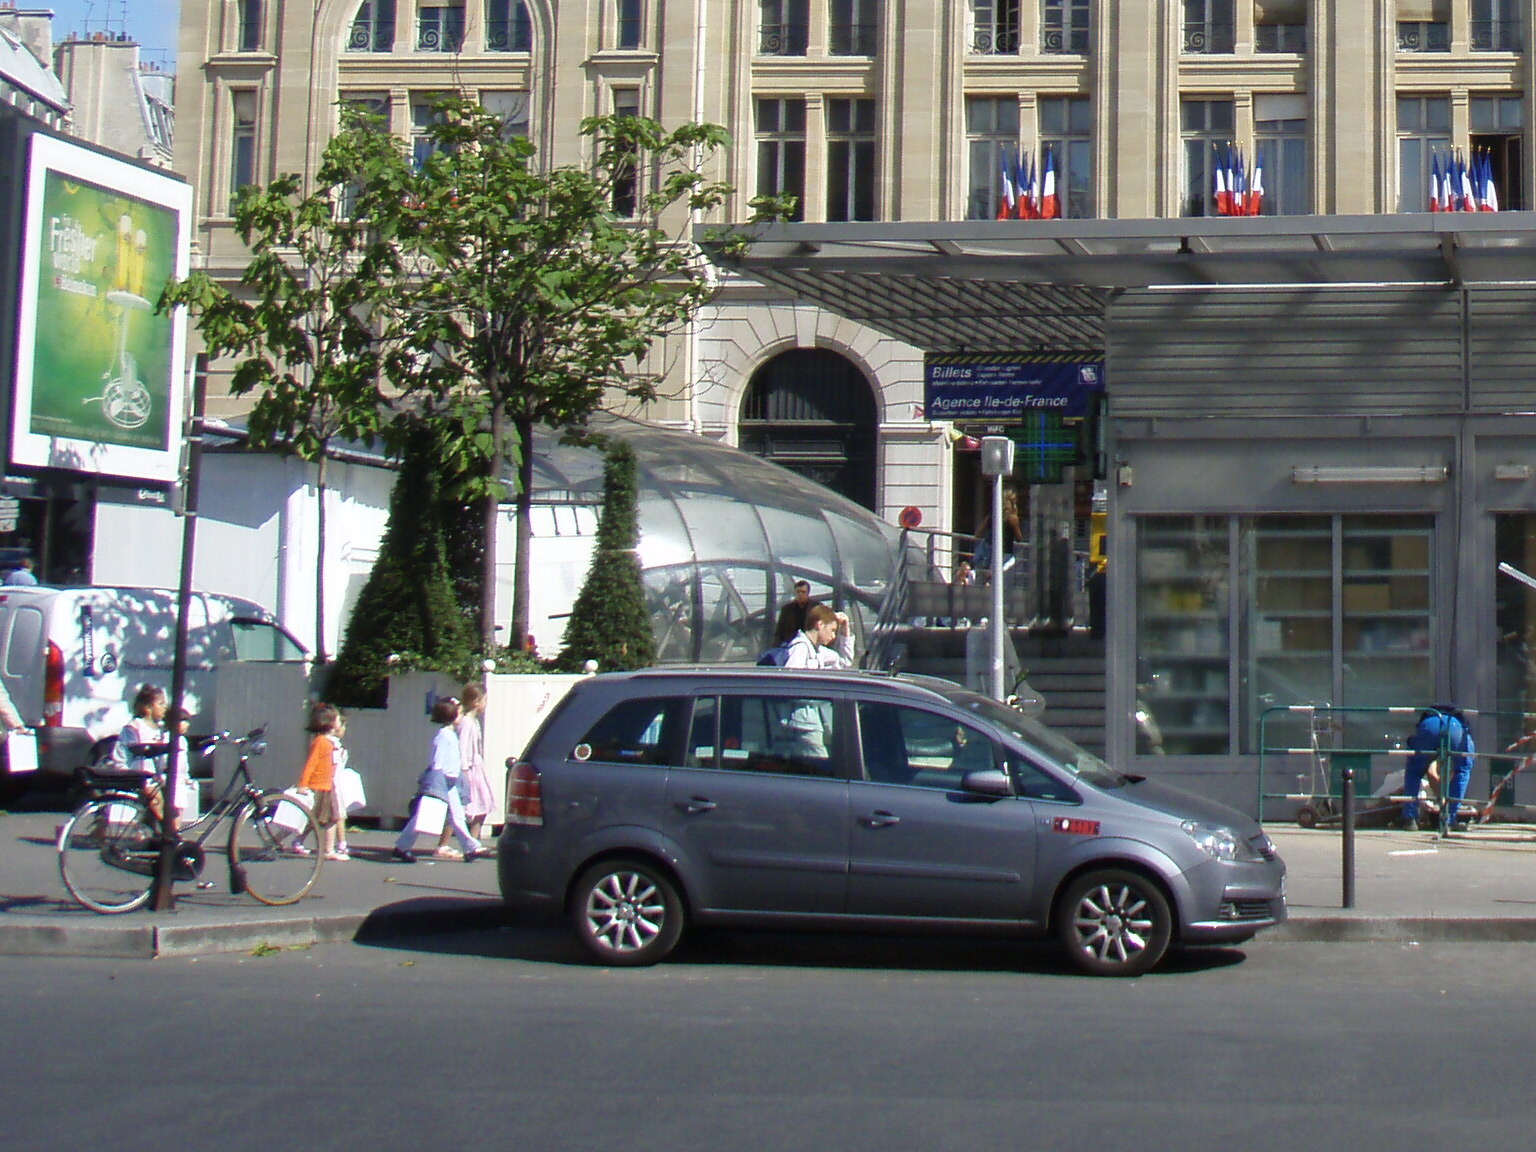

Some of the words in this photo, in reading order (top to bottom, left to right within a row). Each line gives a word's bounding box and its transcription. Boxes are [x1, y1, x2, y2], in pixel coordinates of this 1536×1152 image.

[932, 366, 972, 378] Billets
[931, 397, 981, 410] Agence
[984, 395, 1069, 408] Ile-de-France
